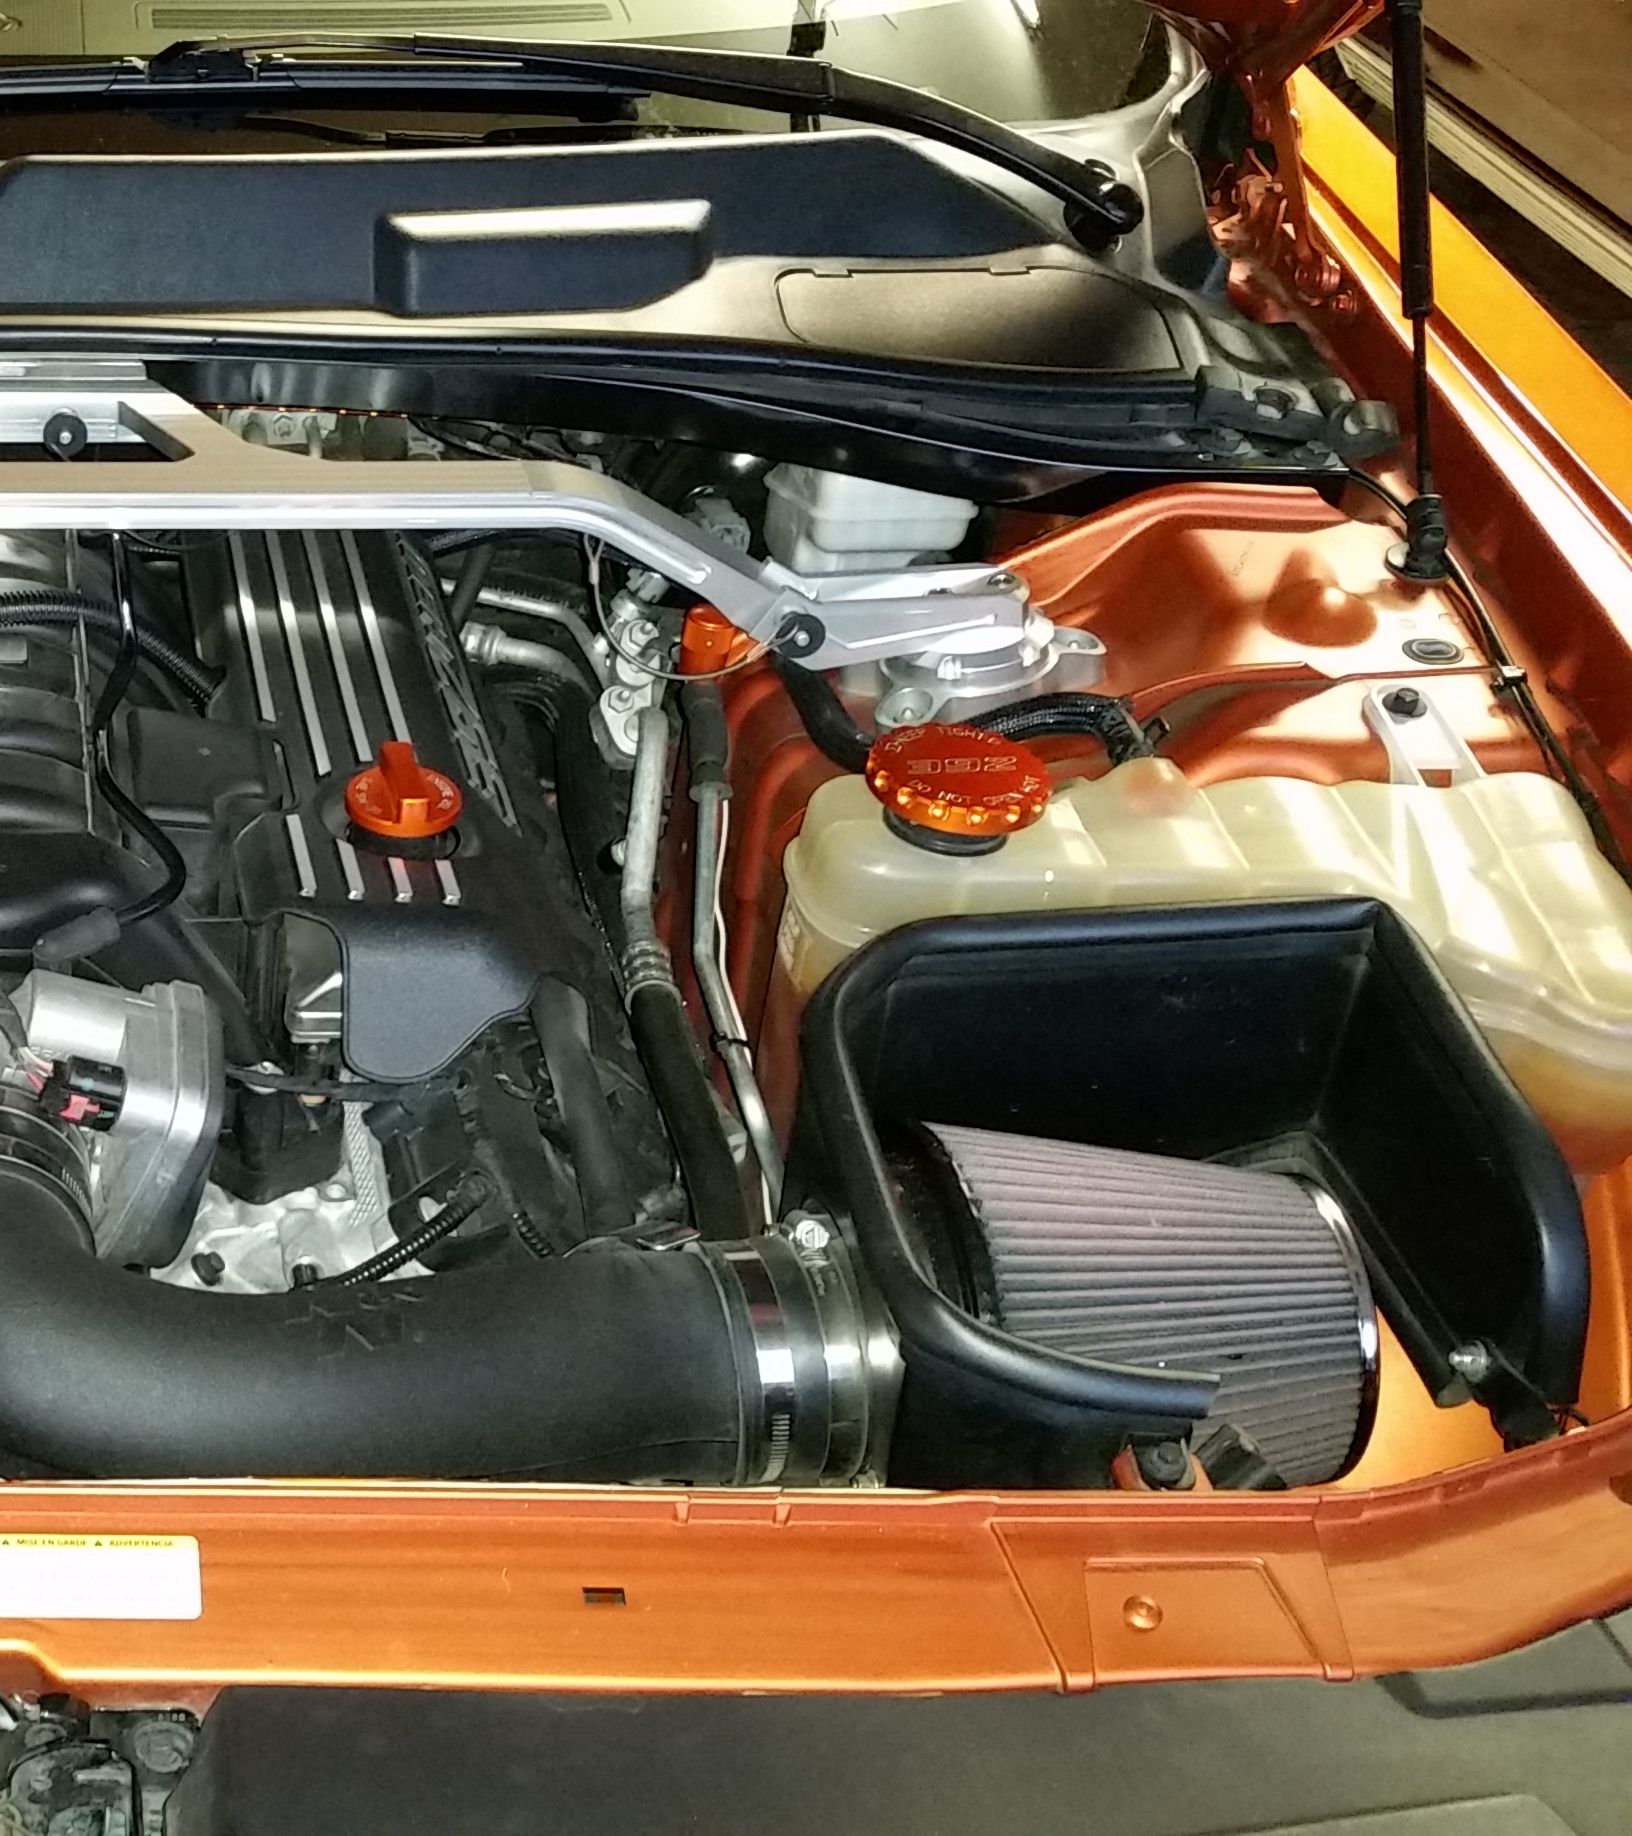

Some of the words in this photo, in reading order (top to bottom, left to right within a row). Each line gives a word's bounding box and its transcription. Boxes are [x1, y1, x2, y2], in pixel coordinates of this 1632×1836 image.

[936, 726, 985, 741] TIGHT
[906, 755, 1018, 776] 392
[908, 779, 933, 793] DO
[938, 790, 975, 805] NOT
